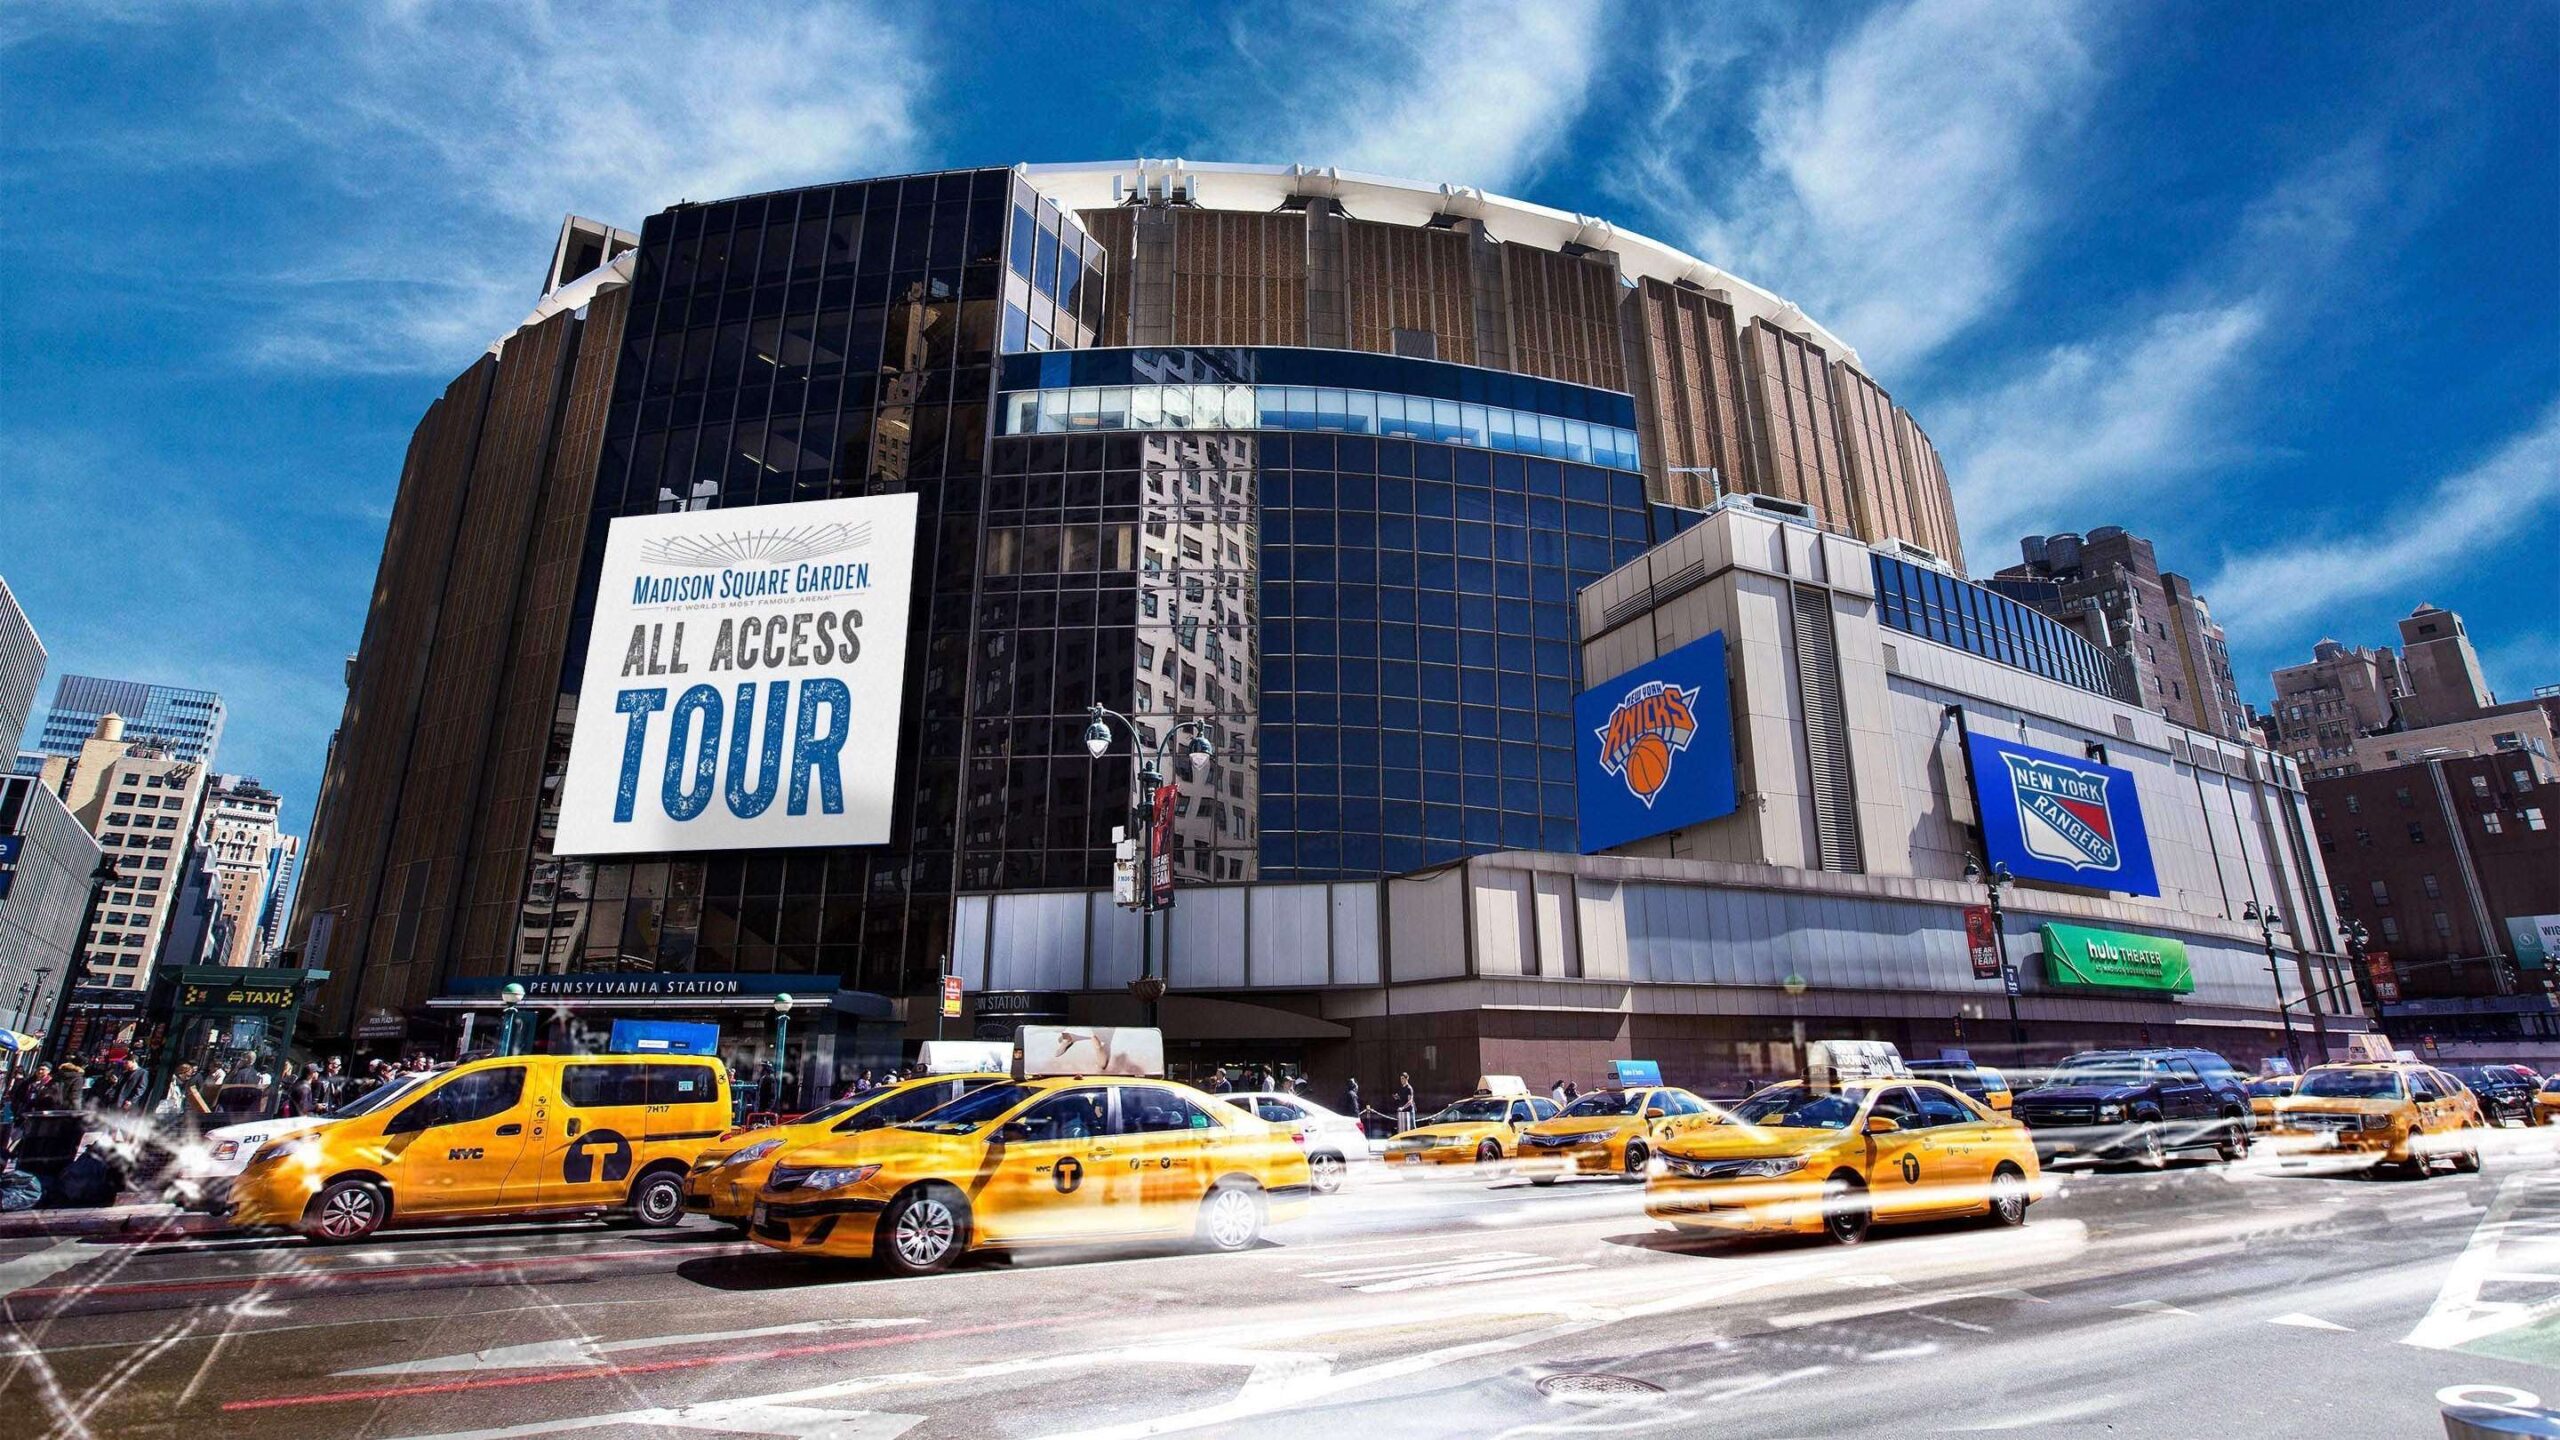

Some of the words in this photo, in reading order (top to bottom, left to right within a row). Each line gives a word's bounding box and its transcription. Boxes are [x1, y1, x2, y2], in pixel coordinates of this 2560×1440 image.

[632, 574, 715, 605] MADISON
[720, 569, 790, 599] SQUARE
[665, 605, 681, 613] THE
[685, 602, 726, 611] WORLD'S
[729, 600, 754, 608] MOST
[758, 597, 795, 606] FAMOUS
[621, 621, 688, 677] ALL
[709, 609, 863, 671] ACCESS
[1625, 689, 1641, 707] NEW
[1642, 683, 1662, 698] YORK
[1603, 687, 1693, 762] KNICKS
[613, 677, 851, 823] TOUR
[2016, 767, 2053, 791] NEW
[2057, 777, 2100, 800] YORK
[2034, 796, 2111, 862] RANGERS
[1153, 869, 1171, 887] TEAM
[2087, 938, 2118, 960] hulu
[2120, 947, 2162, 965] THEATER
[529, 981, 659, 994] PENNSYLVANIA
[667, 980, 738, 993] STATION
[245, 991, 280, 1004] TAXI
[988, 995, 1030, 1010] STATION
[647, 1105, 670, 1113] 7H17
[243, 1134, 269, 1144] 203
[448, 1147, 485, 1161] NYC
[1035, 1165, 1051, 1173] NYC
